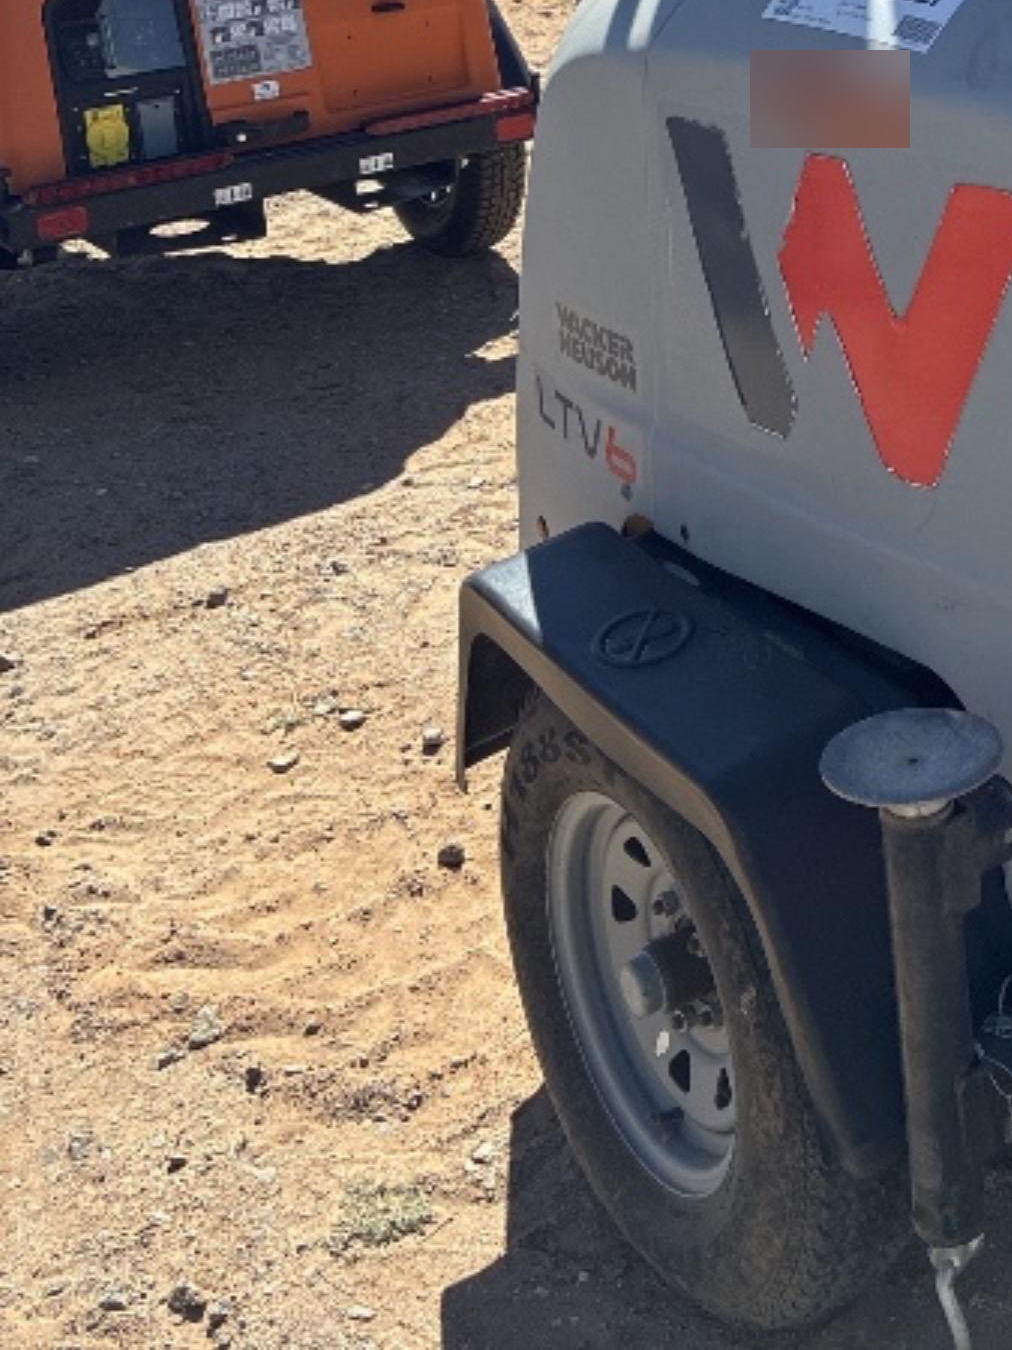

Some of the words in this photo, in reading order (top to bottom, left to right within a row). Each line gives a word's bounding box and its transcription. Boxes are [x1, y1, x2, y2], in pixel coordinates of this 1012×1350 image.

[555, 301, 636, 368] WACKER
[558, 329, 637, 393] NEUSON
[533, 374, 638, 485] LTV6
